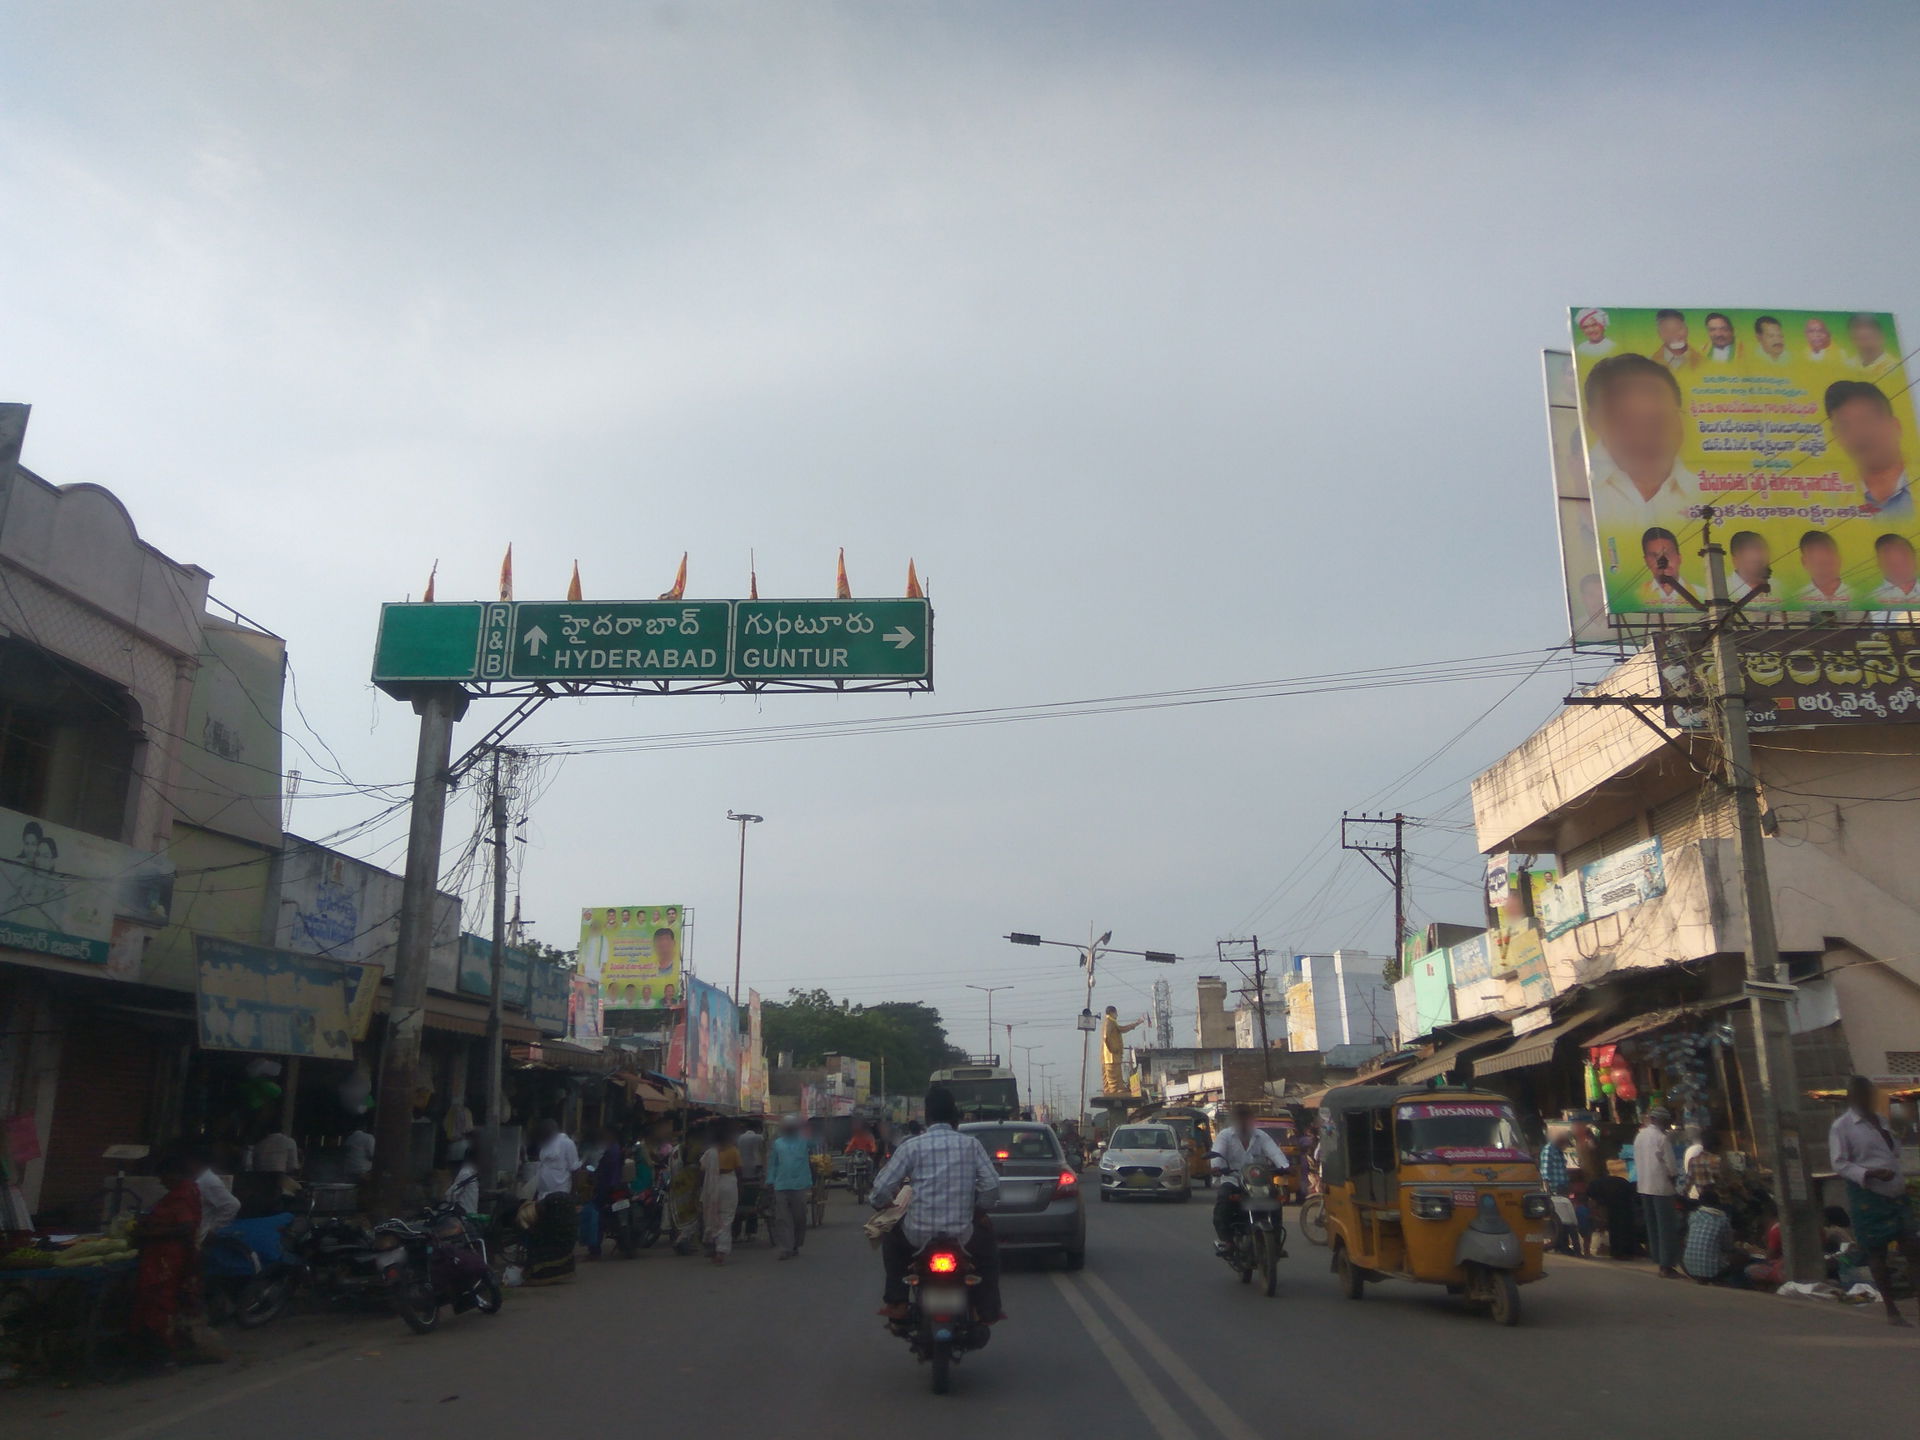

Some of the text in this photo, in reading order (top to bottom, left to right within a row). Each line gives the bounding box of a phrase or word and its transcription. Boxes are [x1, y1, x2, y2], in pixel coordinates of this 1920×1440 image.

[560, 607, 701, 645] హైదరాబాద్
[745, 611, 875, 636] గుంటూరు
[554, 648, 717, 669] HYDERABAD
[743, 647, 849, 669] GUNTUR
[1797, 691, 1888, 718] ఆర్యవైశ్య
[1426, 1105, 1494, 1117] HOSANNA
